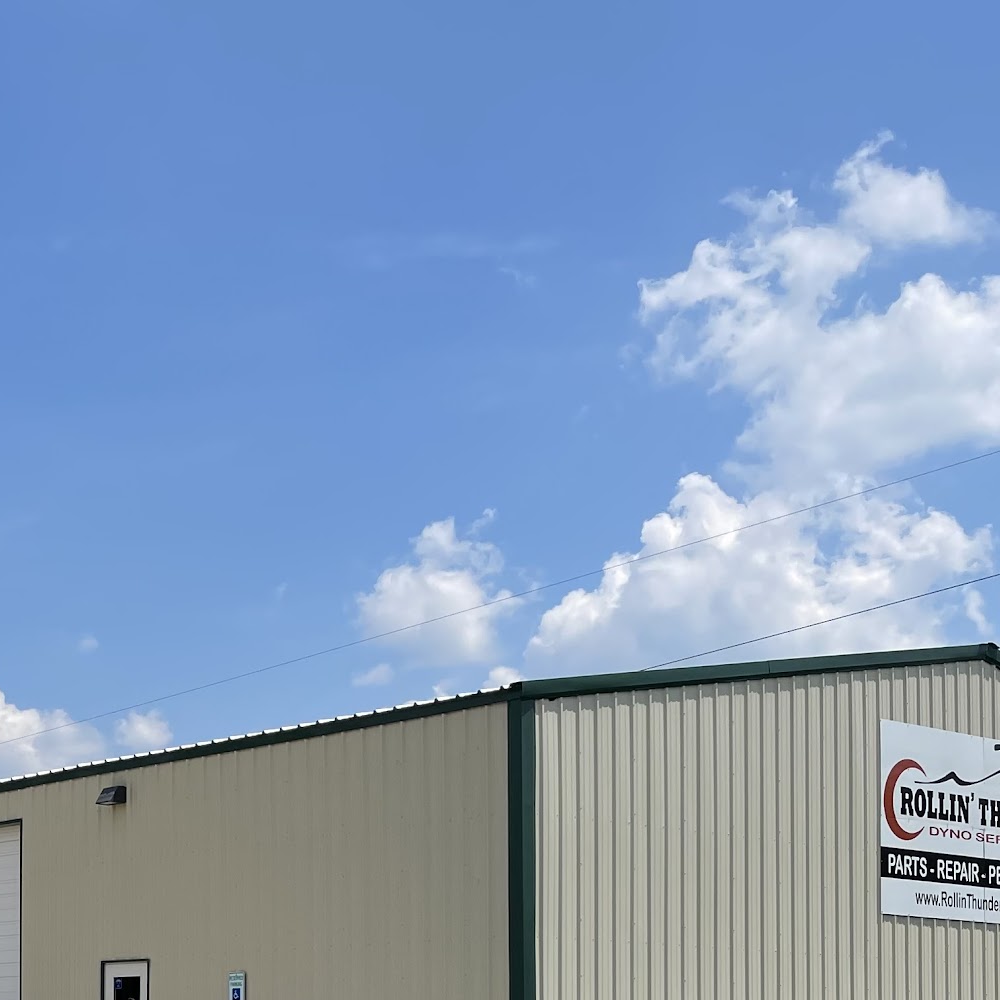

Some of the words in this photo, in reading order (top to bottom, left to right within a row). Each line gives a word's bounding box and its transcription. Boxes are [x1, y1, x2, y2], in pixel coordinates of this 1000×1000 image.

[900, 786, 975, 824] ROLLIN'
[929, 826, 972, 841] DYNO
[887, 853, 928, 878] PARTS
[937, 859, 980, 883] REPAIR
[915, 891, 1000, 912] www.RollinThunde
